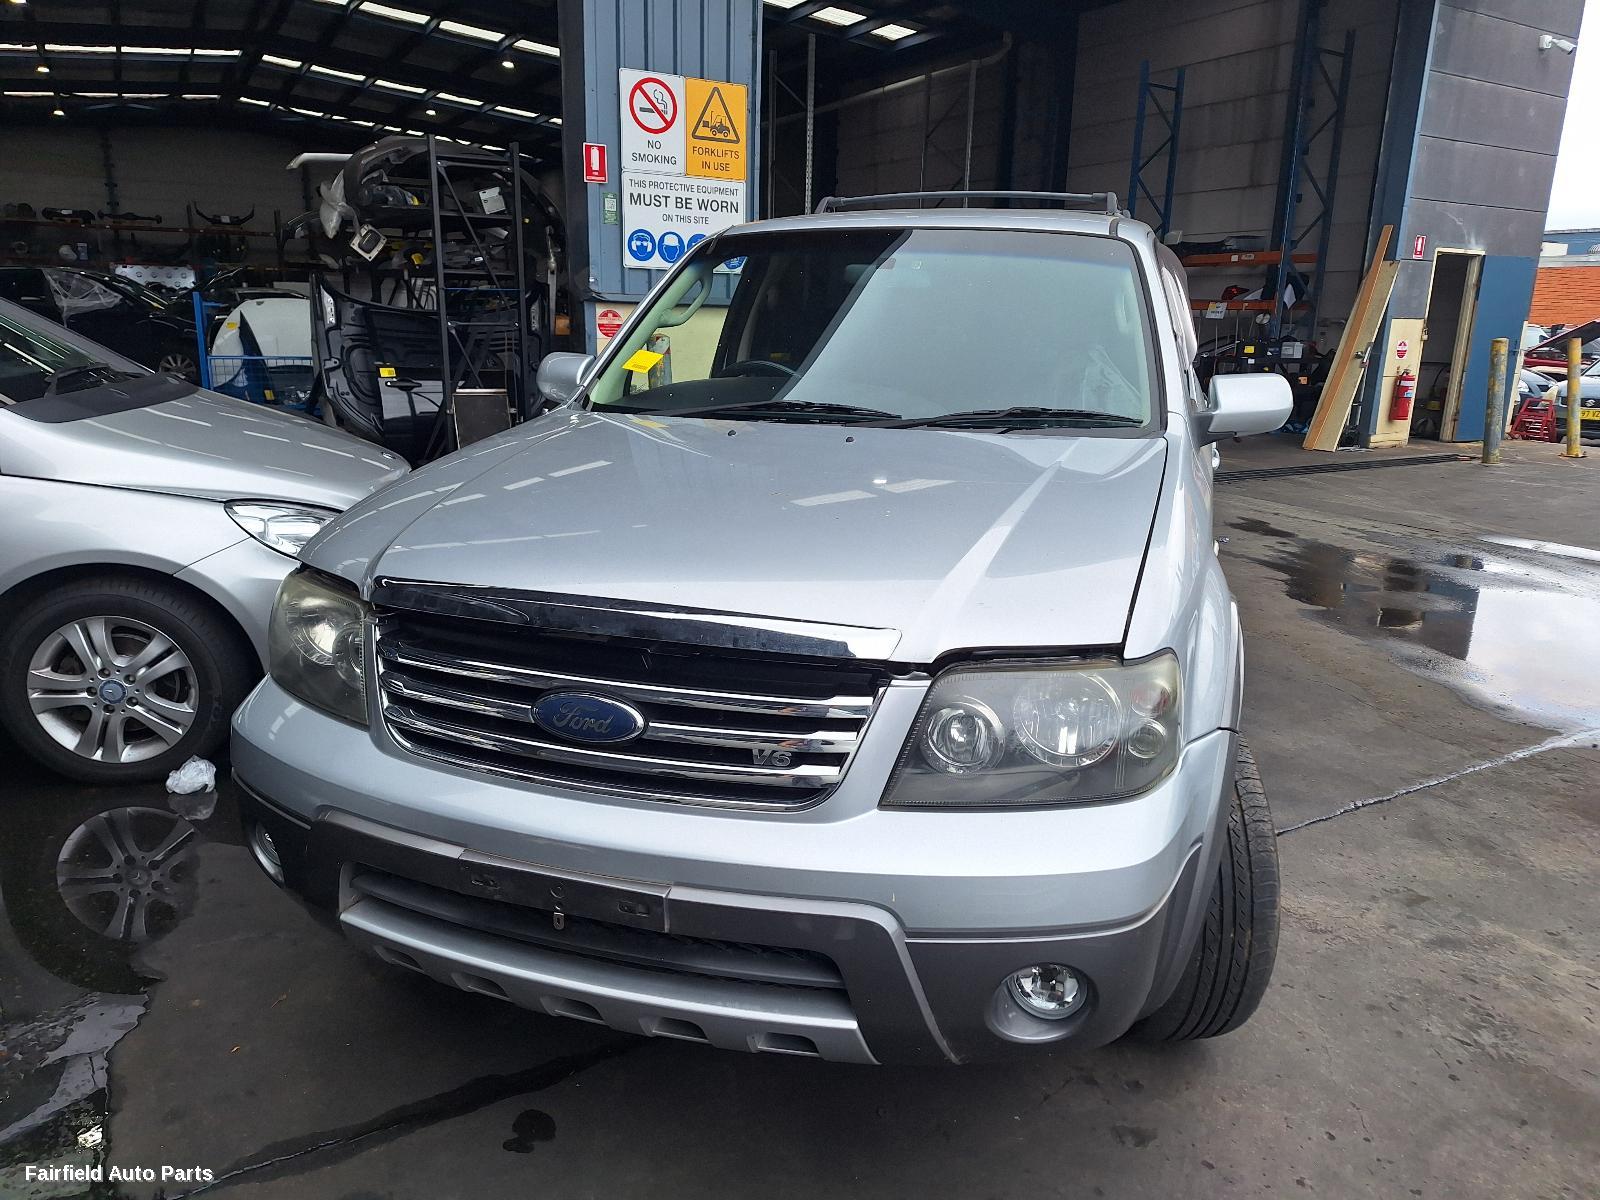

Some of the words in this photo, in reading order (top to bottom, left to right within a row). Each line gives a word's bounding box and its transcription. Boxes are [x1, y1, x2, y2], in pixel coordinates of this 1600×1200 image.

[647, 140, 662, 150] NO
[631, 152, 677, 166] SMOKING
[692, 146, 740, 160] FORKLIFTS
[701, 161, 711, 170] IN
[713, 162, 730, 172] USE
[629, 179, 647, 189] THIS
[648, 180, 695, 193] PROTECTIVE
[696, 185, 739, 197] EQUIPMENT
[629, 192, 671, 208] MUST
[675, 196, 693, 210] BE
[697, 198, 739, 214] WORN
[662, 214, 674, 223] ON
[675, 215, 692, 224] THIS
[693, 216, 709, 225] SITE
[552, 701, 615, 734] Ford
[752, 746, 792, 767] V6
